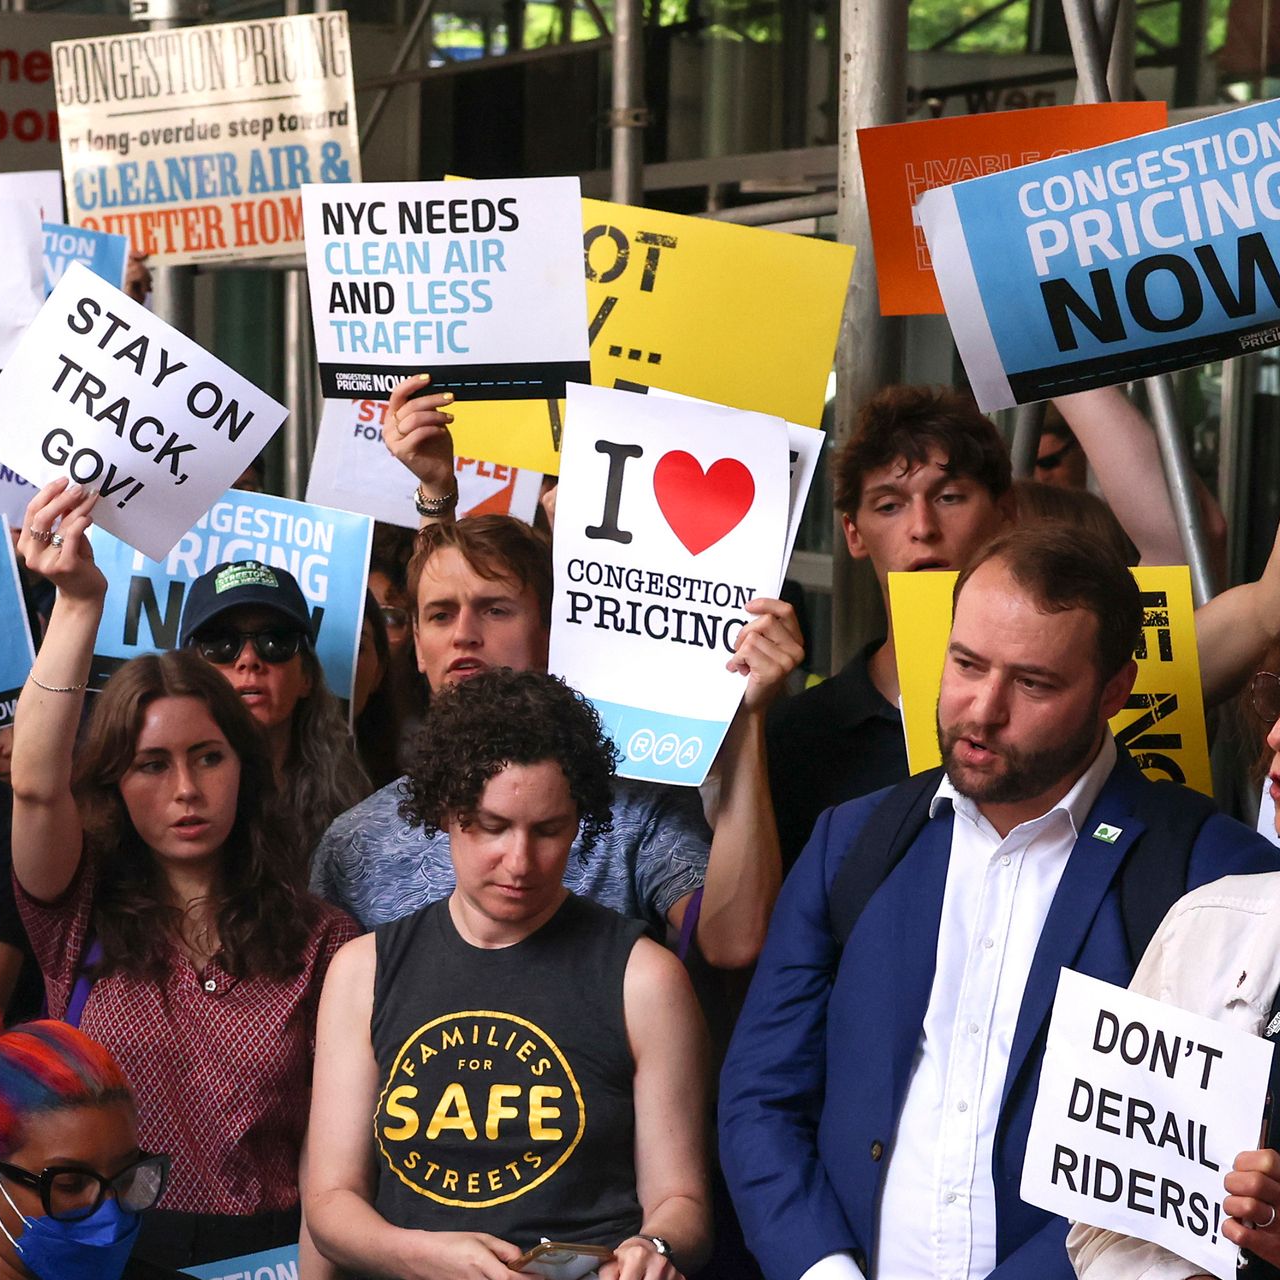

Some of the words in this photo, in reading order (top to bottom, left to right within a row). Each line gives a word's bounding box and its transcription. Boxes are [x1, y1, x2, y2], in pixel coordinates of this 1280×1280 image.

[55, 30, 230, 107] CONGESTION
[233, 14, 348, 88] PRICNG
[86, 118, 220, 155] long-overdue
[228, 117, 273, 141] step
[73, 153, 243, 211] CLEANER
[248, 144, 313, 194] AIR
[320, 141, 352, 183] &
[231, 197, 307, 247] HOM
[322, 201, 388, 236] NYC
[398, 197, 520, 235] NEEDS
[324, 240, 431, 276] CLEAN
[443, 238, 507, 274] AIR
[329, 281, 395, 315] AND
[406, 279, 493, 315] LESS
[329, 320, 470, 354] TRAFFIC
[67, 297, 189, 388] STAY
[186, 381, 255, 443] ON
[335, 372, 371, 382] CONGESTION
[337, 379, 372, 392] PRICING
[51, 353, 198, 486] TRACK,
[41, 427, 145, 510] GOV!
[585, 440, 644, 545] I
[567, 559, 756, 611] CONGESTION
[631, 733, 700, 765] RPA
[401, 1025, 551, 1078] FAMILIES
[458, 1059, 492, 1071] FOR
[383, 1082, 563, 1142] SAFE
[1067, 1077, 1220, 1171] DERAIL
[404, 1150, 542, 1193] STREETS
[1051, 1143, 1220, 1244] RIDERS!
